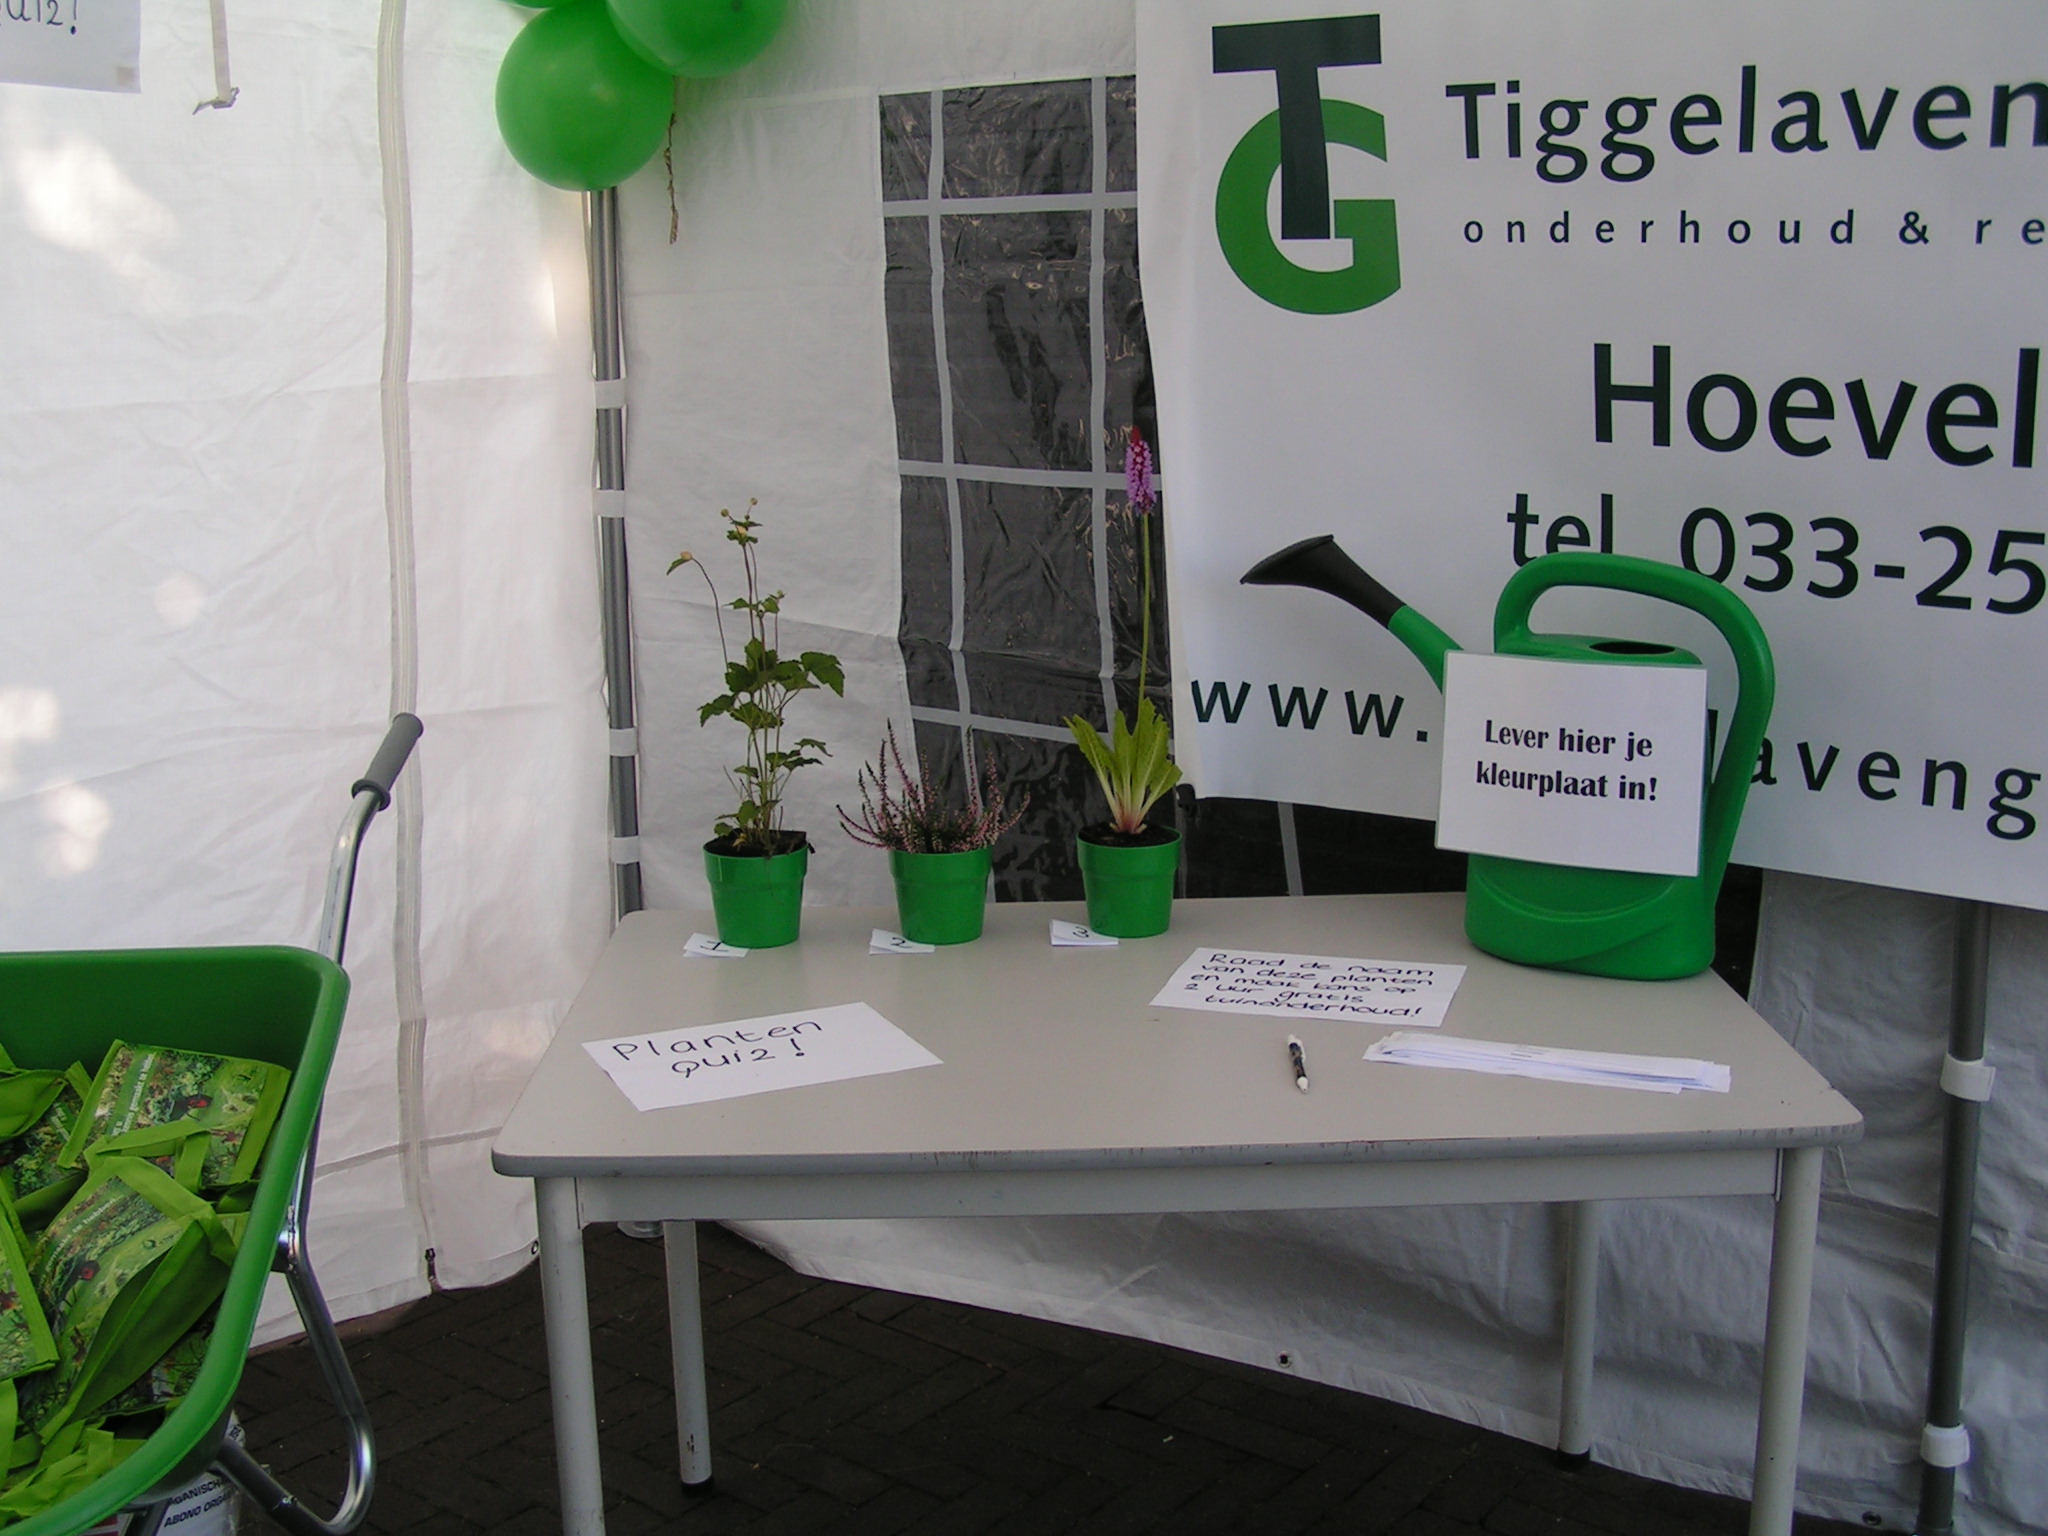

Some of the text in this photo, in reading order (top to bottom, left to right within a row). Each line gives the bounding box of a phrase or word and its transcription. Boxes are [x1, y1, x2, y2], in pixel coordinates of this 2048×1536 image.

[1445, 64, 2048, 184] Tiggelaven
[1463, 209, 1854, 245] onderhoud
[1898, 210, 1930, 245] &
[1593, 342, 2041, 469] Hoevel
[1679, 507, 2047, 615] 033-25
[1190, 679, 1428, 743] www.
[1485, 719, 1653, 762] Lever hier je
[1476, 760, 1657, 801] kleurplaat in!
[1202, 964, 1245, 974] van
[1209, 953, 1434, 976] Raad de naam
